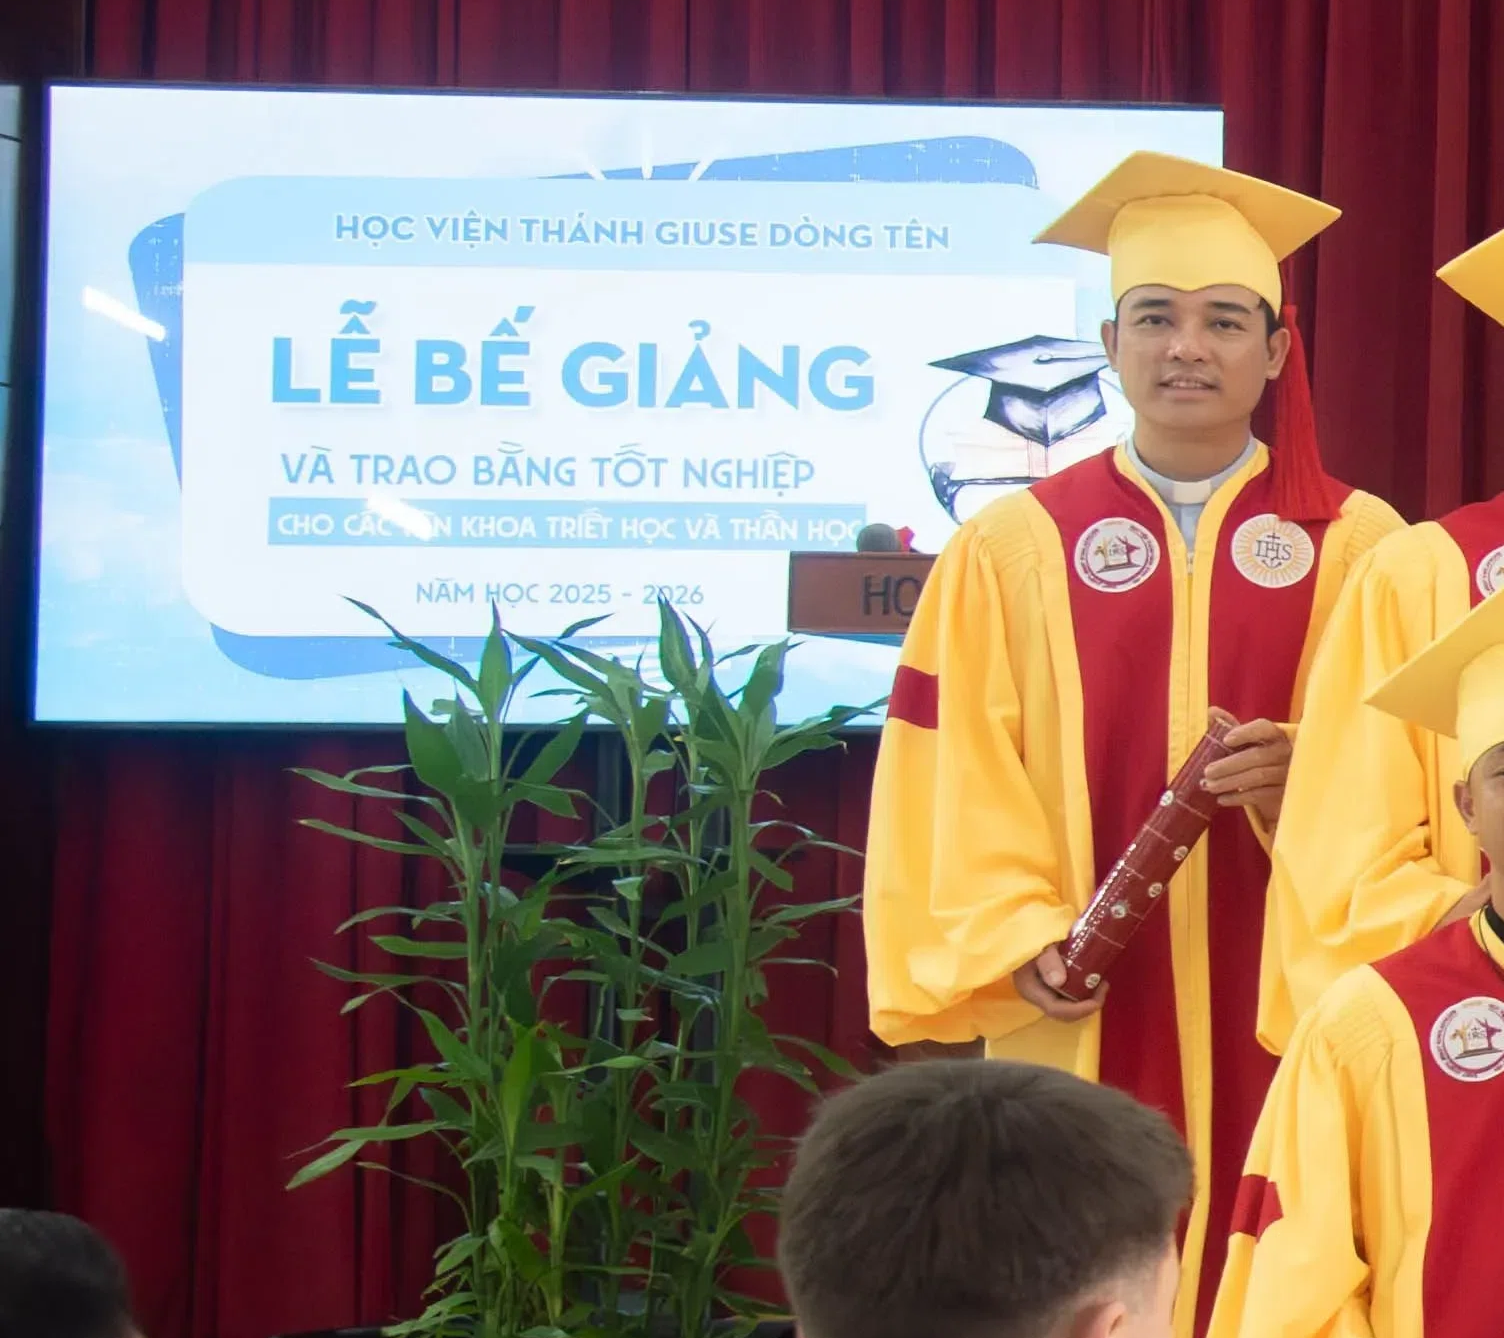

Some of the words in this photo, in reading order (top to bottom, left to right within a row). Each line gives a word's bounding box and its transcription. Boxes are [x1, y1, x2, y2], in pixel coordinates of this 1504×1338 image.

[335, 215, 415, 247] HỌC
[426, 211, 508, 249] VIỆN
[520, 212, 643, 246] THÁNH
[655, 221, 758, 248] GIUSE
[769, 217, 874, 250] DÒNG
[884, 217, 950, 250] TÊN
[271, 299, 381, 406] LỄ
[415, 306, 536, 407] BẾ
[561, 319, 875, 411] GIẢNG
[281, 446, 335, 487] VÀ
[351, 454, 456, 487] TRAO
[590, 443, 668, 489] TỐT
[684, 451, 814, 497] NGHIỆP
[277, 513, 334, 536] CHO
[461, 516, 537, 539] KHOA
[546, 507, 613, 540] TRIẾT
[621, 518, 677, 544] HỌC
[685, 513, 722, 541] VÀ
[808, 519, 865, 547] HỌC
[416, 577, 475, 604] NĂM
[485, 582, 539, 608] HỌC
[550, 584, 612, 605] 2025
[642, 584, 704, 605] 2026
